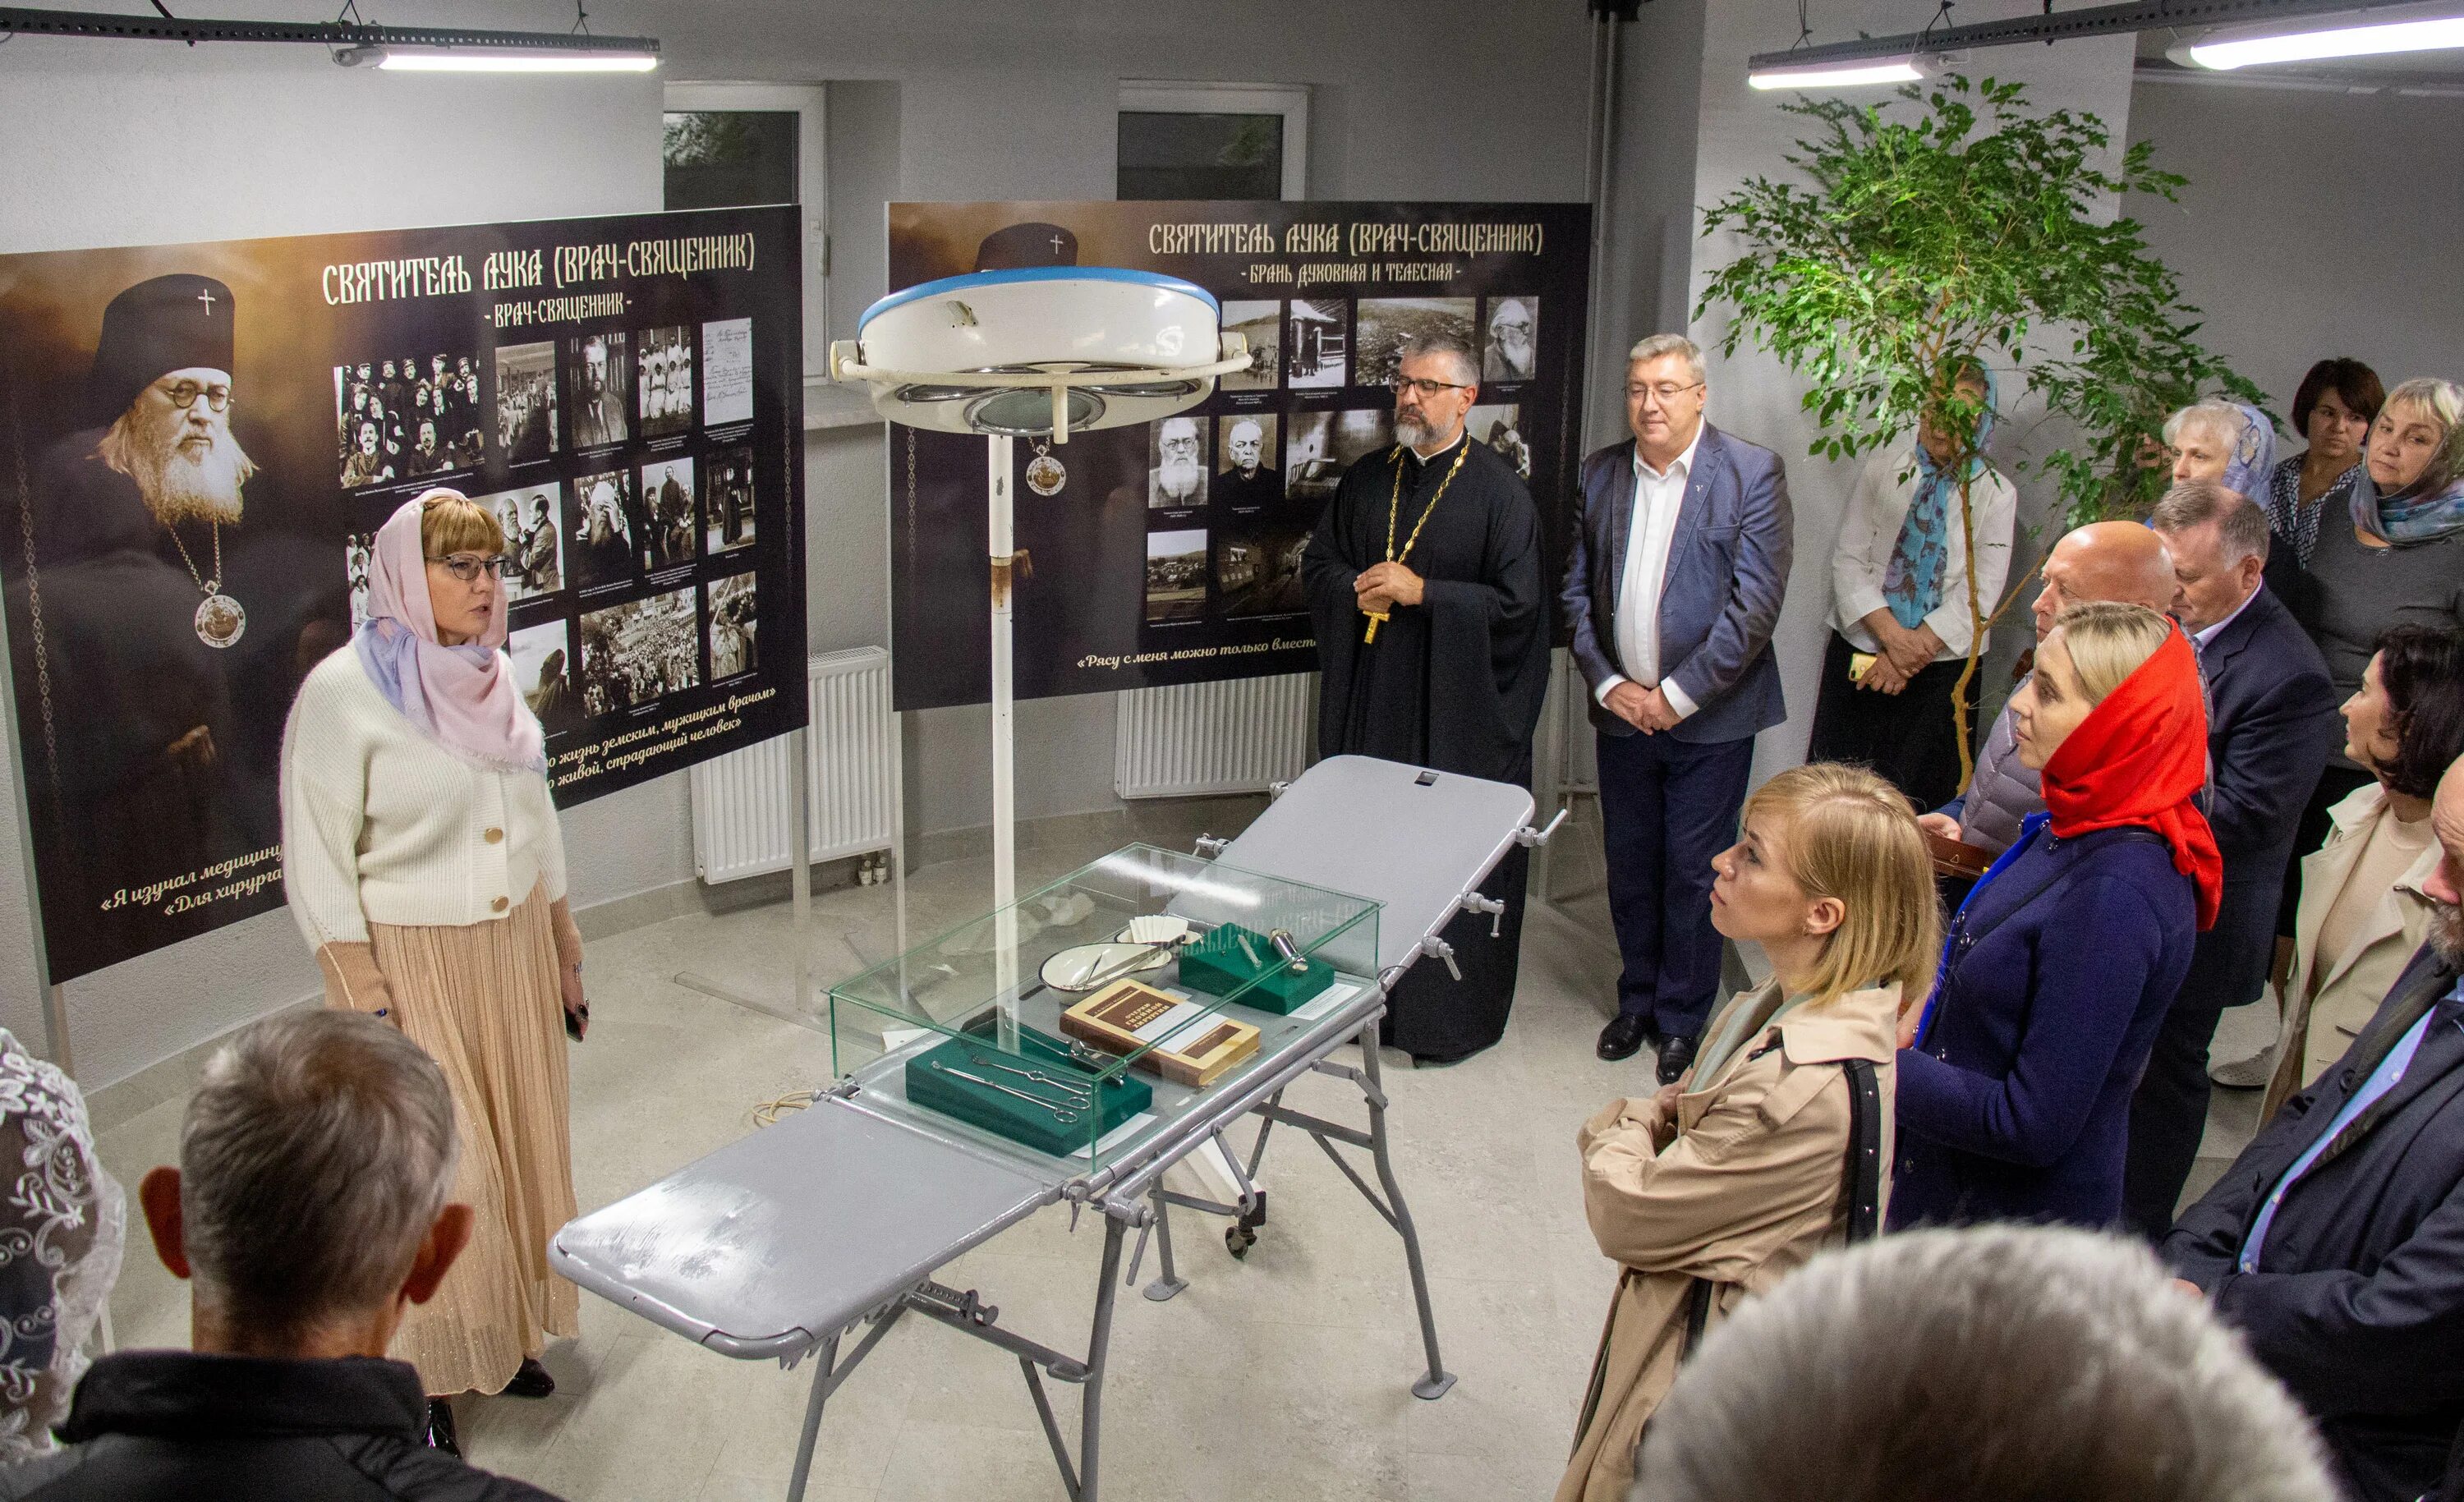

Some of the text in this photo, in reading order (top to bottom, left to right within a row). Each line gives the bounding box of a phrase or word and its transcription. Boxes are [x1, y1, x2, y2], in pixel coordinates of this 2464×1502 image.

[1149, 223, 1543, 258] СВЯТИТЕЛЬ ЛУКА (ВРАЧ-СВЯЩЕННИК)
[322, 233, 755, 305] СВЯТИТЕЛЬ ЛУКА (ВРАЧ-СВЯЩЕННИК)
[1298, 264, 1366, 288] ДУХОВНАЯ
[1372, 264, 1380, 281] И
[1077, 637, 1316, 669] «Рясу с меня можно только вмест
[559, 744, 600, 764] жизнь
[602, 725, 660, 756] земским,
[660, 704, 726, 733] мужицким
[727, 687, 776, 711] врачом»
[558, 761, 604, 786] живой,
[606, 735, 687, 770] страдающий
[689, 718, 742, 742] человек»
[100, 844, 283, 911] «Я изучал медицину
[163, 868, 283, 916] «Для хирурга
[1124, 1002, 1151, 1019] ОЧЕРКИ
